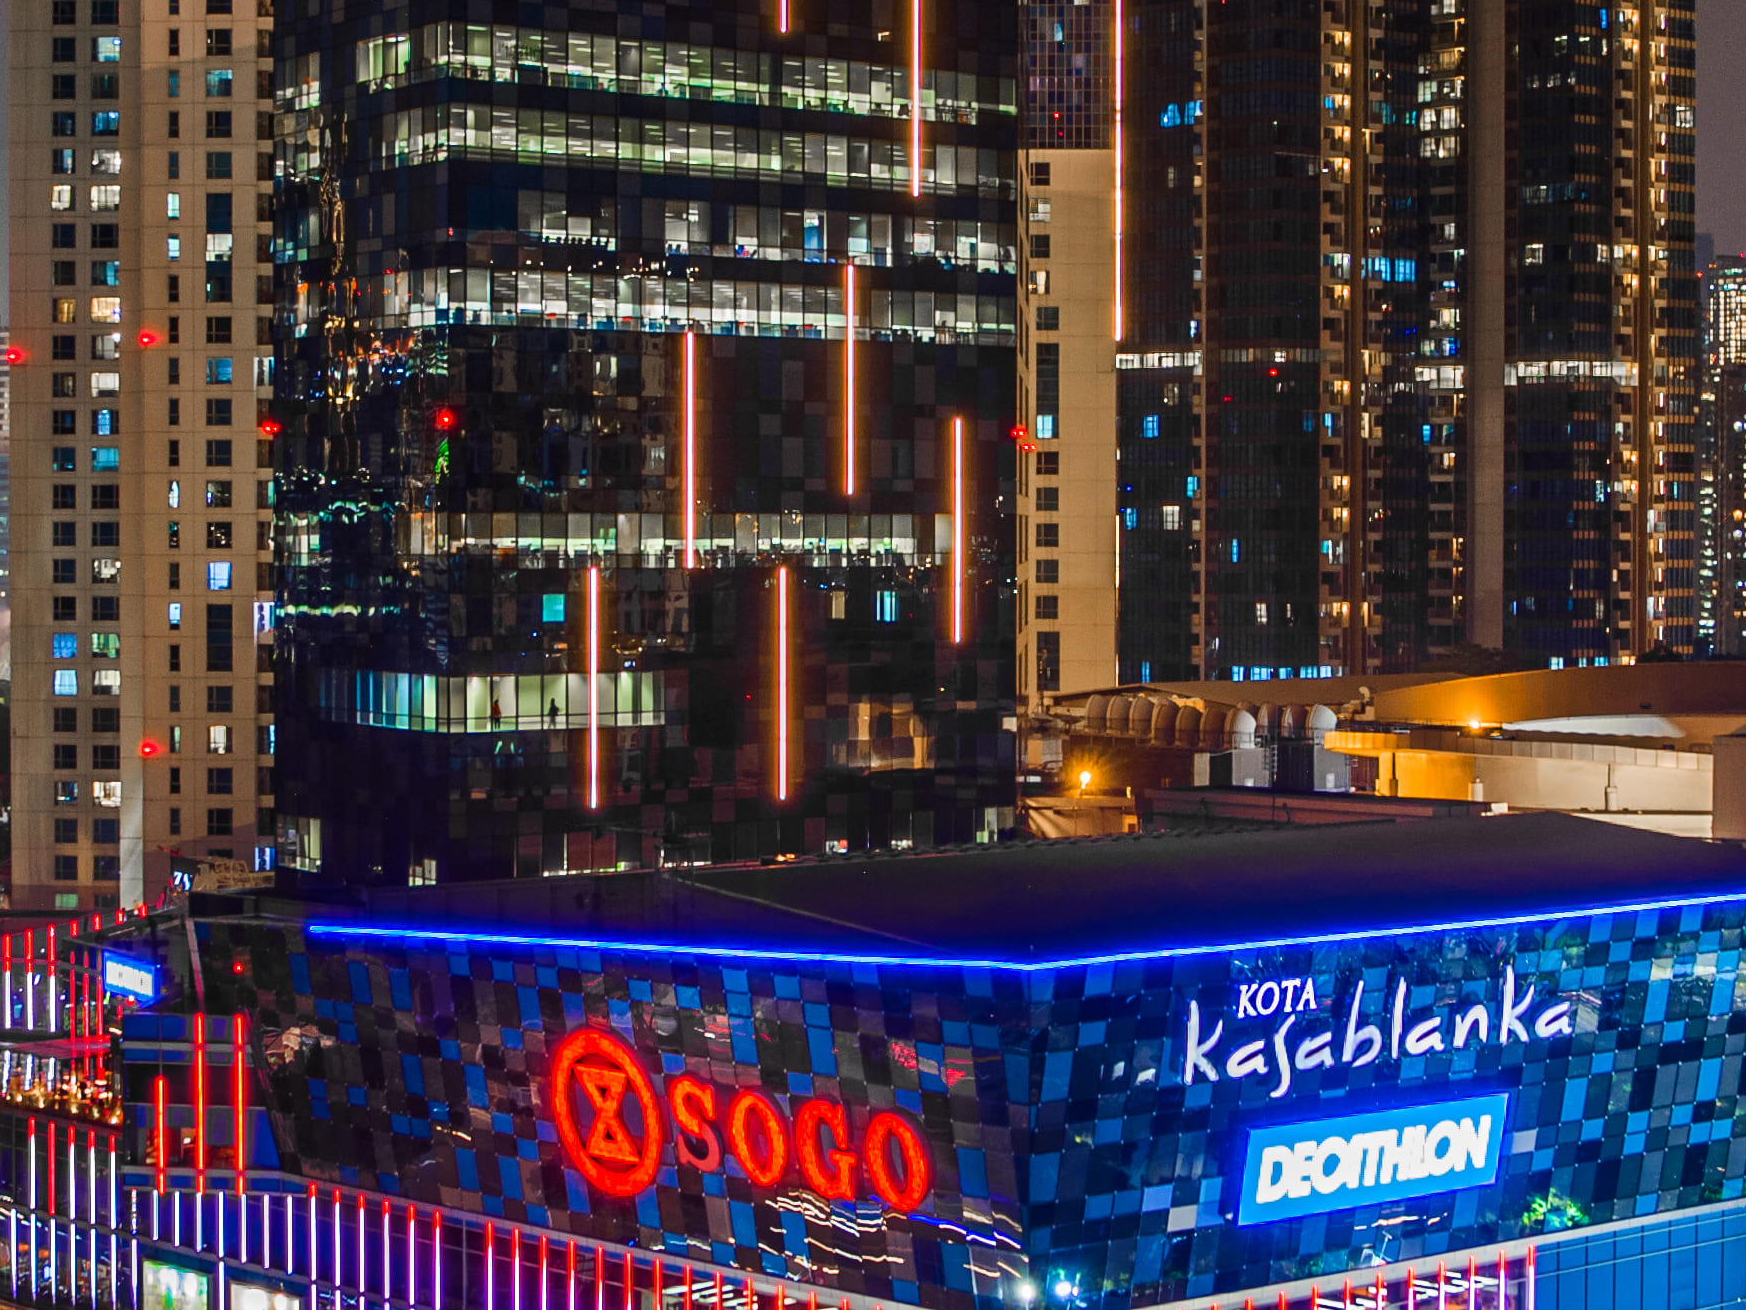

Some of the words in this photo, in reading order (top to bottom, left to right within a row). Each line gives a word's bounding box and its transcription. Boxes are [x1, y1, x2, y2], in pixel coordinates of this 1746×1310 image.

[1237, 977, 1317, 1019] KOTA
[669, 1075, 929, 1213] SOGO
[1256, 1114, 1492, 1204] DECATHLON
